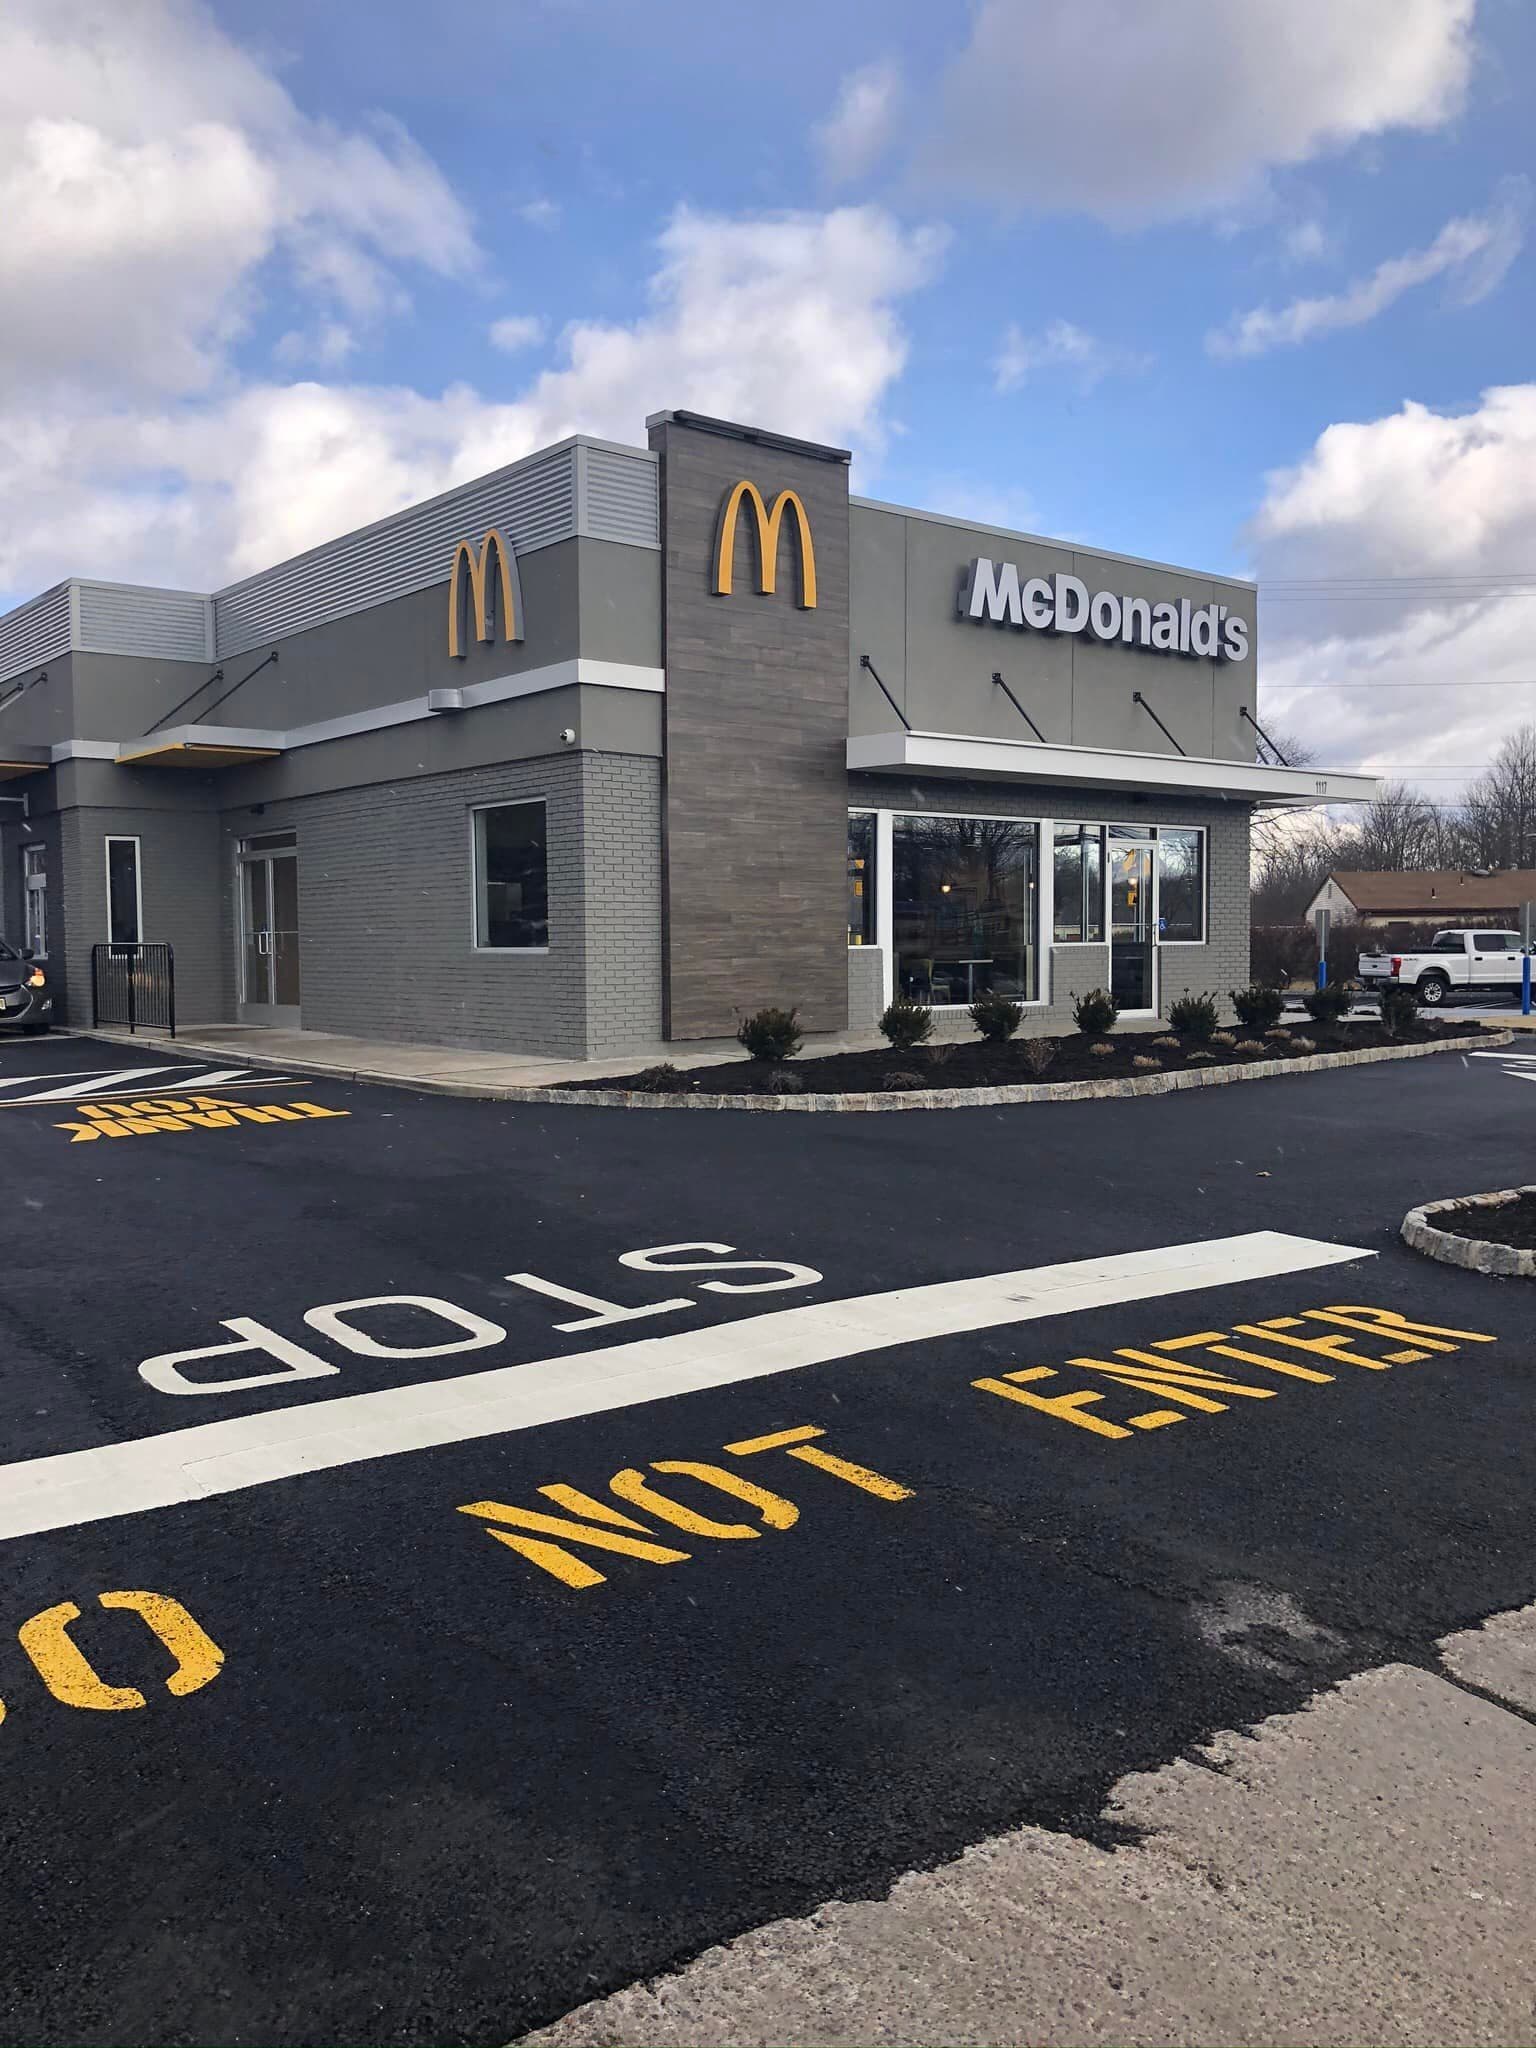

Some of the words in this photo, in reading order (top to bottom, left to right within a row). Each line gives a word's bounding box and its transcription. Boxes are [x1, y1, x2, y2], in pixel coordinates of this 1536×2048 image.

[448, 528, 525, 658] M
[711, 480, 817, 610] M
[964, 556, 1249, 662] McDonald's
[52, 1102, 352, 1142] THANK
[76, 1096, 249, 1119] YOU
[138, 1242, 824, 1395] STOP
[0, 1589, 225, 1726] O
[455, 1424, 917, 1589] NOT
[970, 1305, 1499, 1439] ENTER
